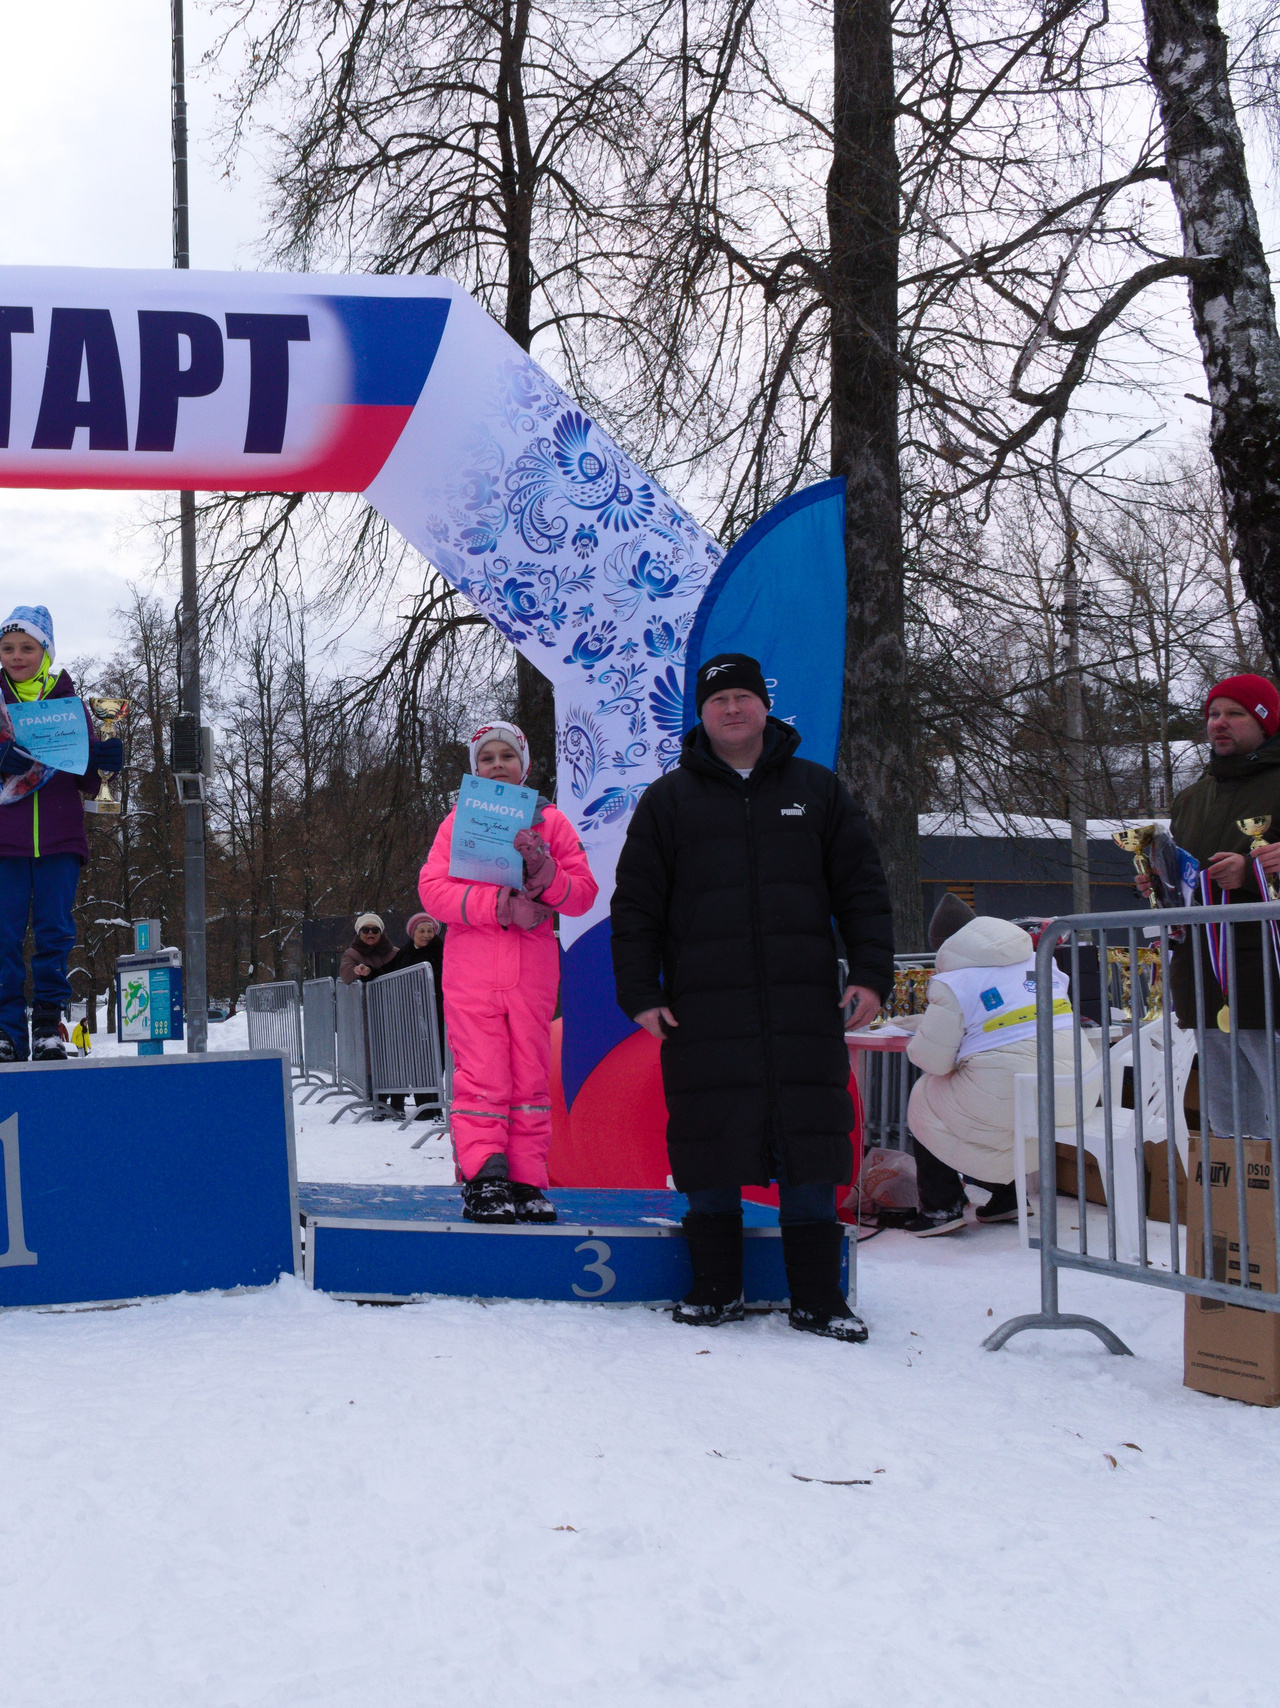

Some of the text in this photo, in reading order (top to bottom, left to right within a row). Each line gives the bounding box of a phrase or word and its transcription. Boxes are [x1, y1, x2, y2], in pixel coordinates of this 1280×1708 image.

[19, 712, 78, 727] ГРАМОТА
[465, 798, 524, 820] ГРАМОТА
[1247, 1163, 1270, 1176] DS10
[571, 1239, 617, 1298] 3
